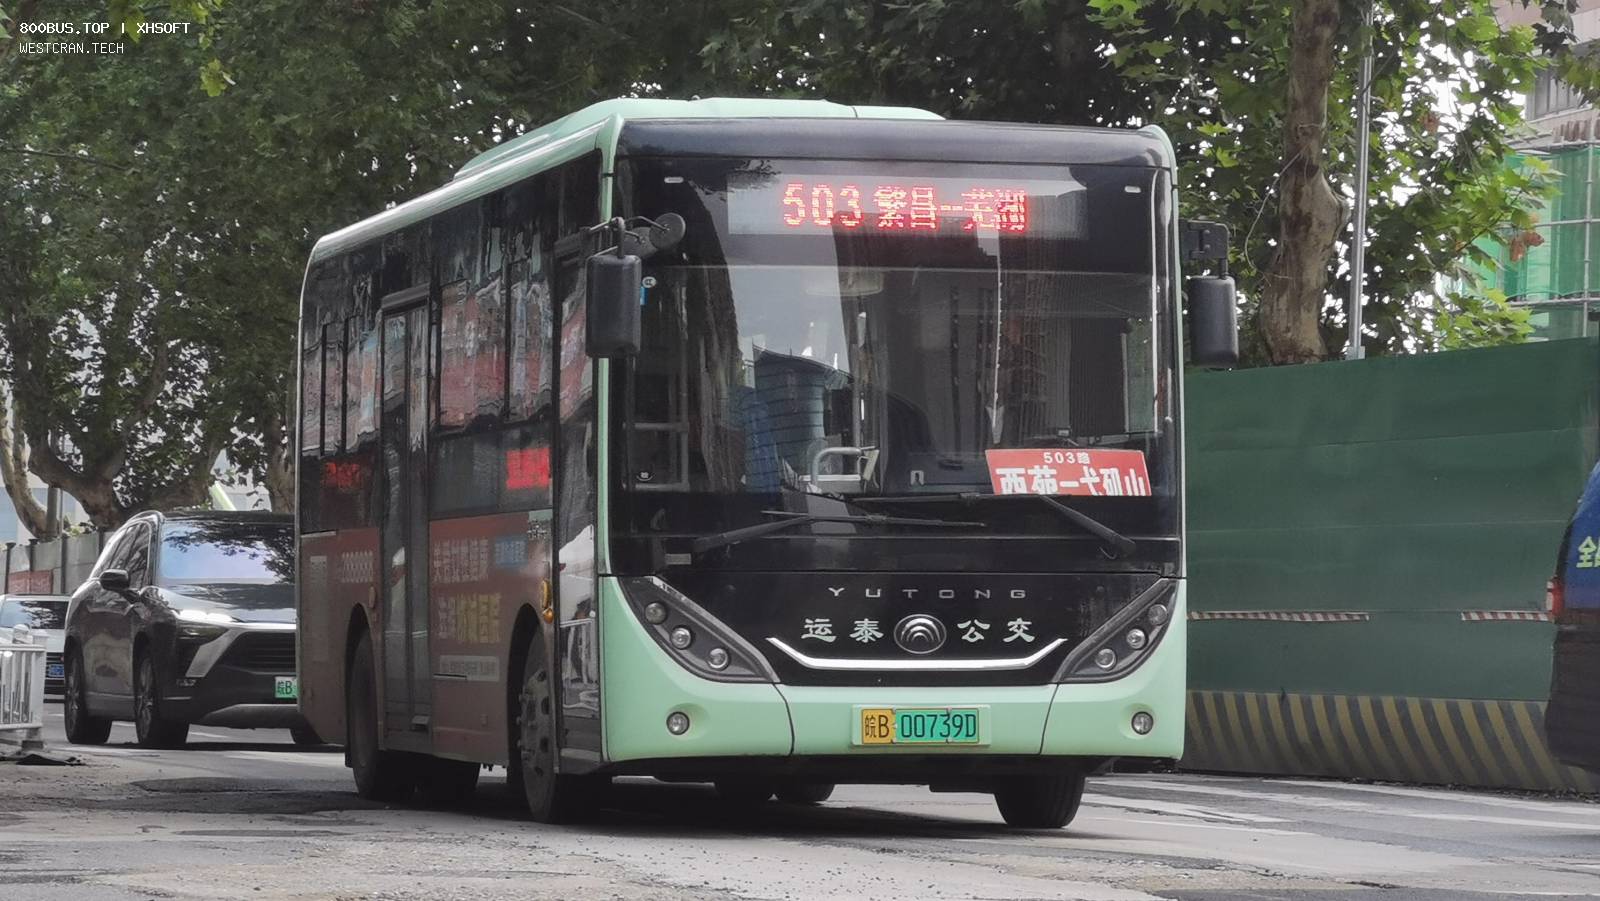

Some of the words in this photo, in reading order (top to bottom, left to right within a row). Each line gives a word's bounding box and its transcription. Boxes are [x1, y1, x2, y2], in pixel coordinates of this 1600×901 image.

[783, 183, 862, 229] 503
[828, 587, 1026, 599] YUTONG
[800, 617, 885, 643] 运泰
[956, 617, 1036, 643] 公交
